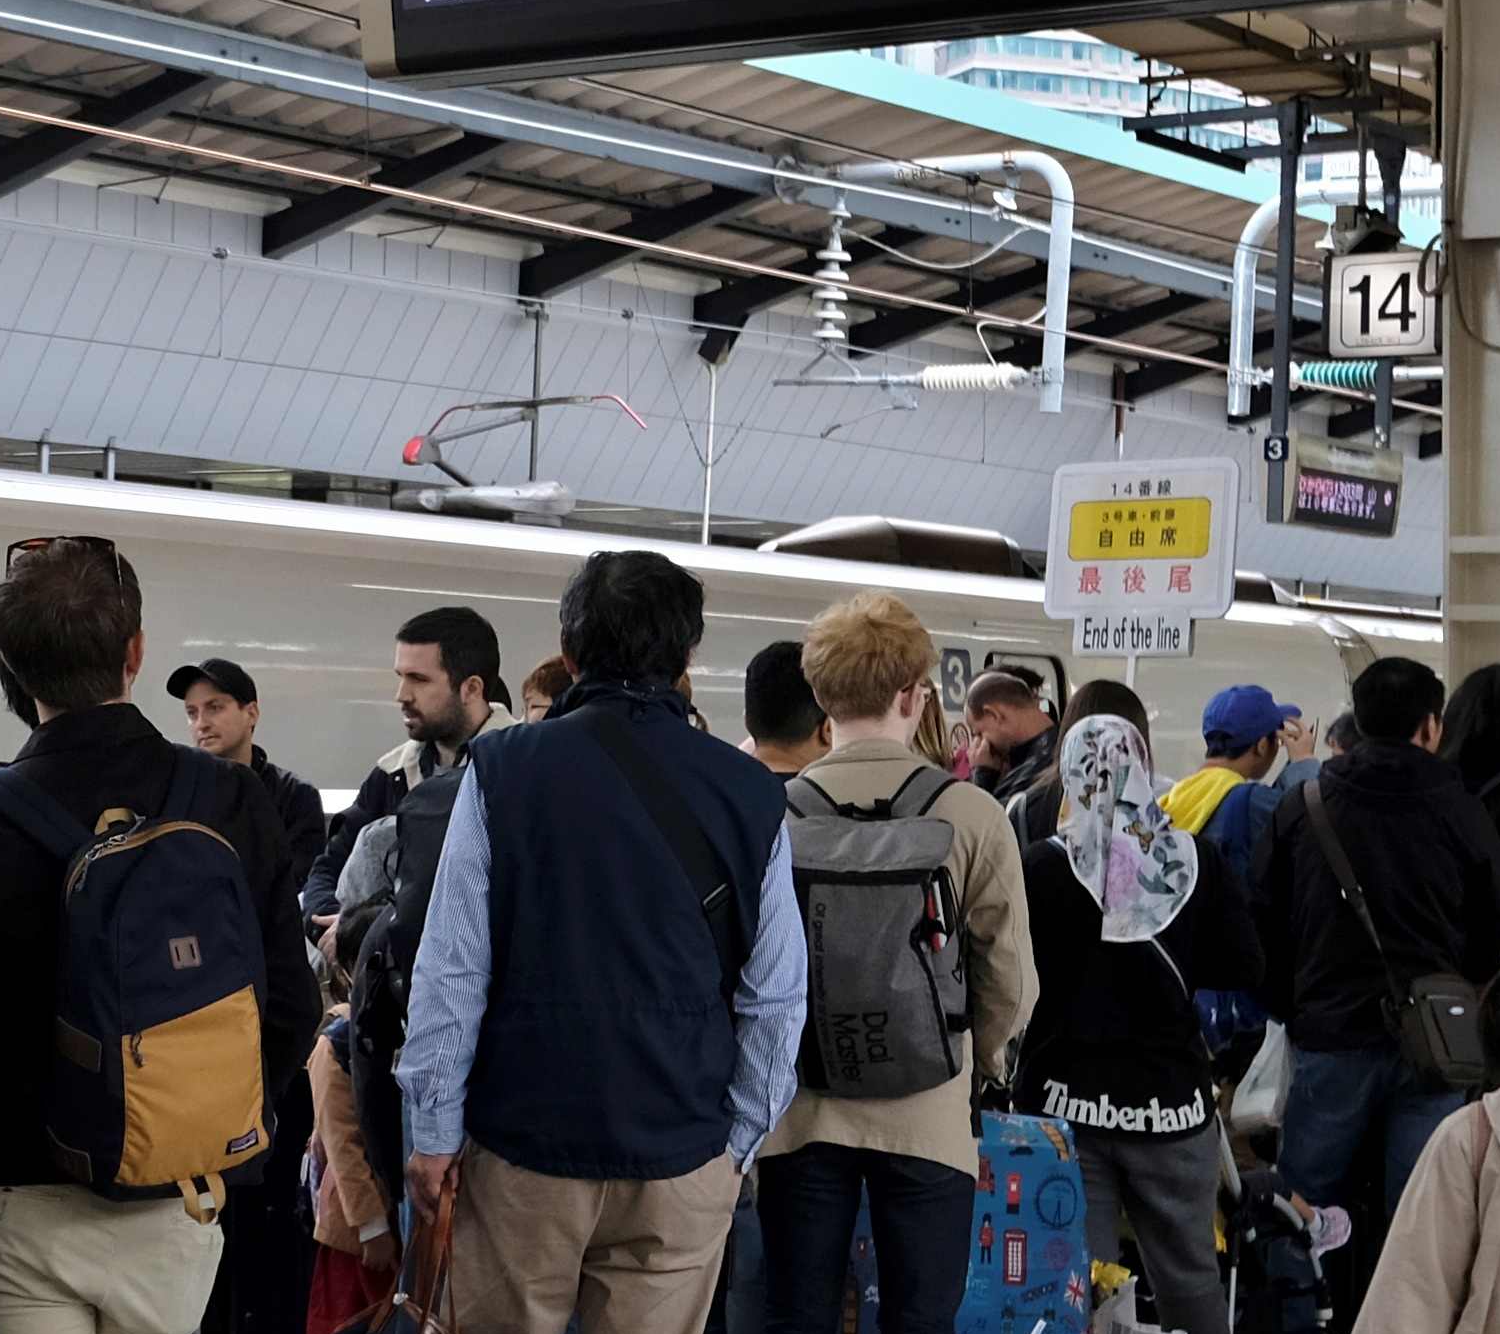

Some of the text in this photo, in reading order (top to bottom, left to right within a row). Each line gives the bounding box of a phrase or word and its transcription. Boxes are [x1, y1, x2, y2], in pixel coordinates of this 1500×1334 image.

[1349, 272, 1416, 335] 14
[1268, 439, 1282, 458] 3
[1099, 526, 1176, 547] 自由席
[1078, 565, 1192, 593] 最後尾
[1083, 617, 1179, 649] End of the line
[947, 655, 966, 705] 3
[862, 1010, 894, 1064] Dual
[1042, 1079, 1206, 1133] Timberland
